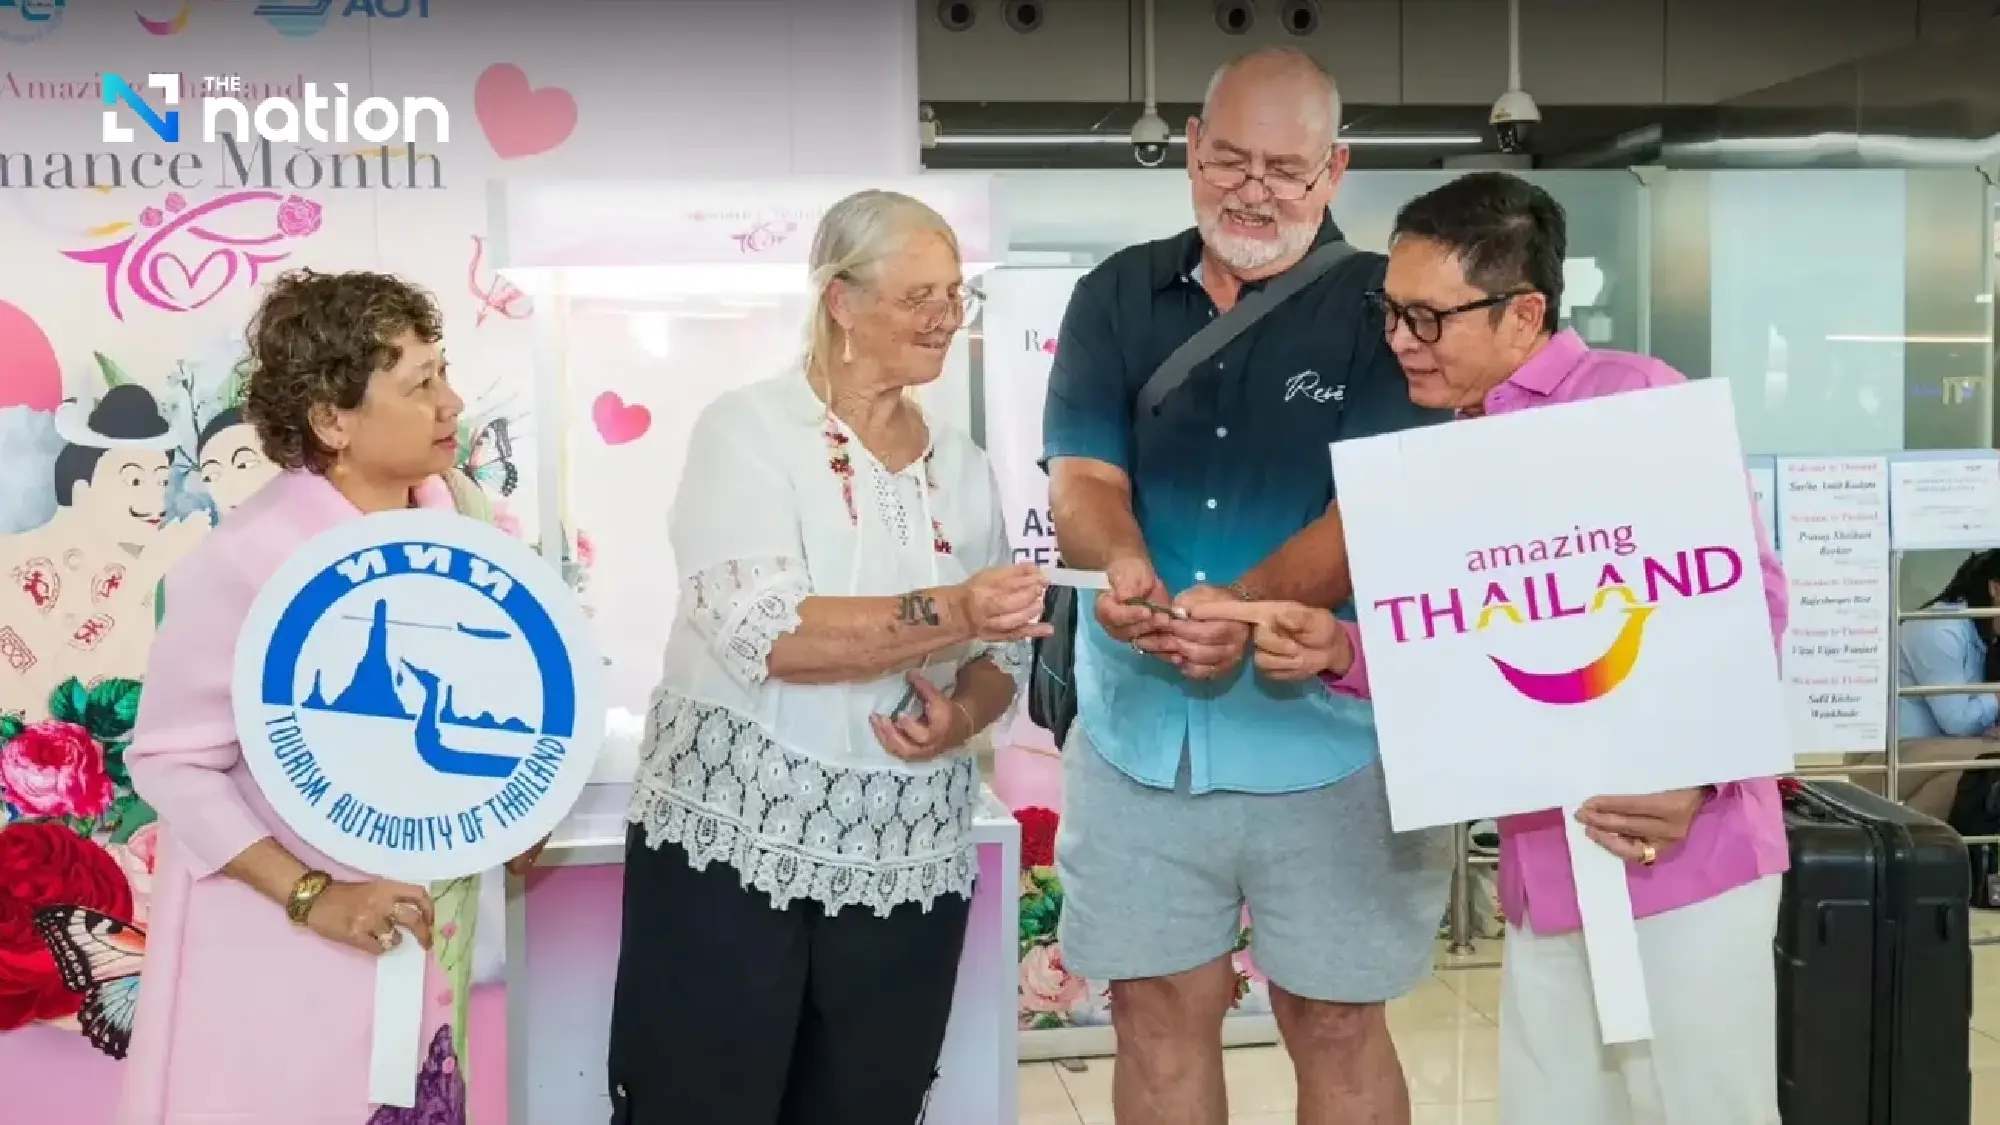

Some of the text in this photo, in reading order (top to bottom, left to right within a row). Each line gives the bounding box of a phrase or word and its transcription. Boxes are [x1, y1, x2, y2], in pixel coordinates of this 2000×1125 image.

[220, 131, 447, 190] Month
[1466, 524, 1637, 573] amazing
[1374, 545, 1743, 643] THAILAND
[265, 711, 566, 852] TOURISM AUTHORITY OF THAILAND
